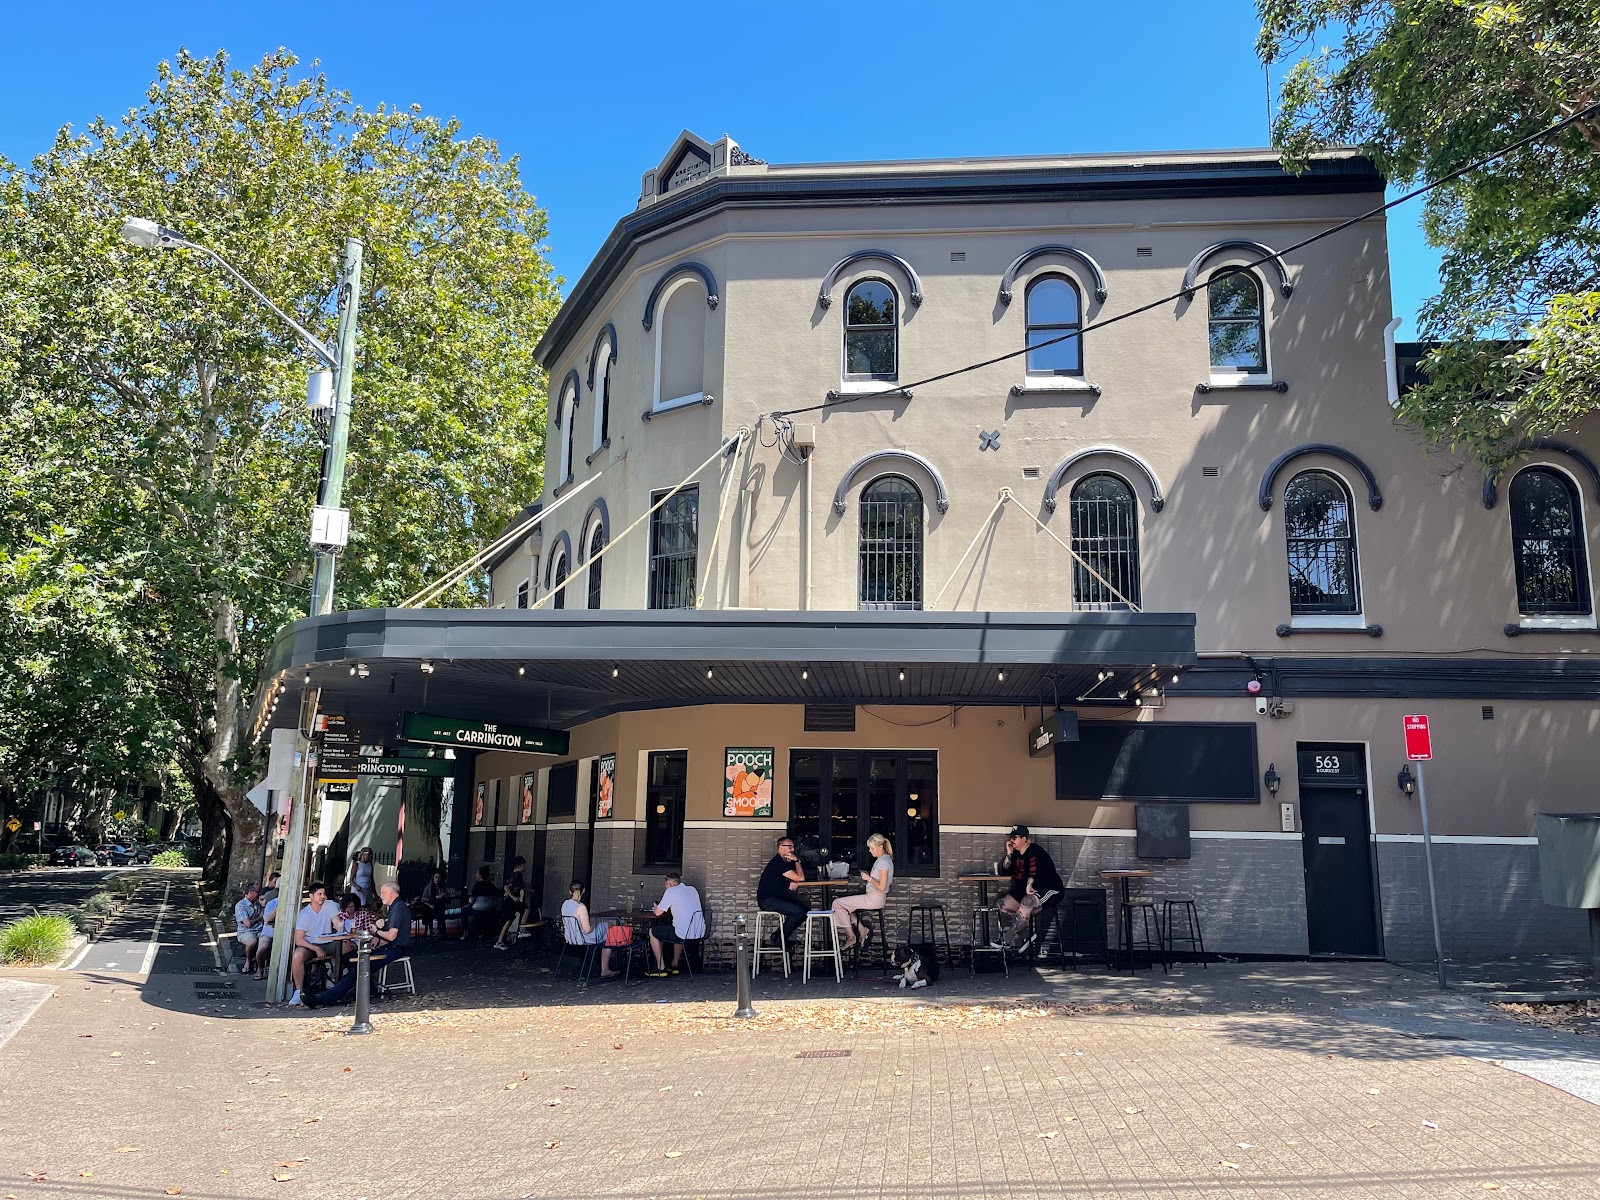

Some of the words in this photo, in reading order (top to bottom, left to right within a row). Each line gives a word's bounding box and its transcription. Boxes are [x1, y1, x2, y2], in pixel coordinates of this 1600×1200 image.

[484, 724, 497, 733] THE
[456, 730, 521, 748] CARRINGTON
[728, 754, 772, 766] POOCH
[1315, 756, 1340, 769] 563
[726, 796, 771, 808] SMOOCH
